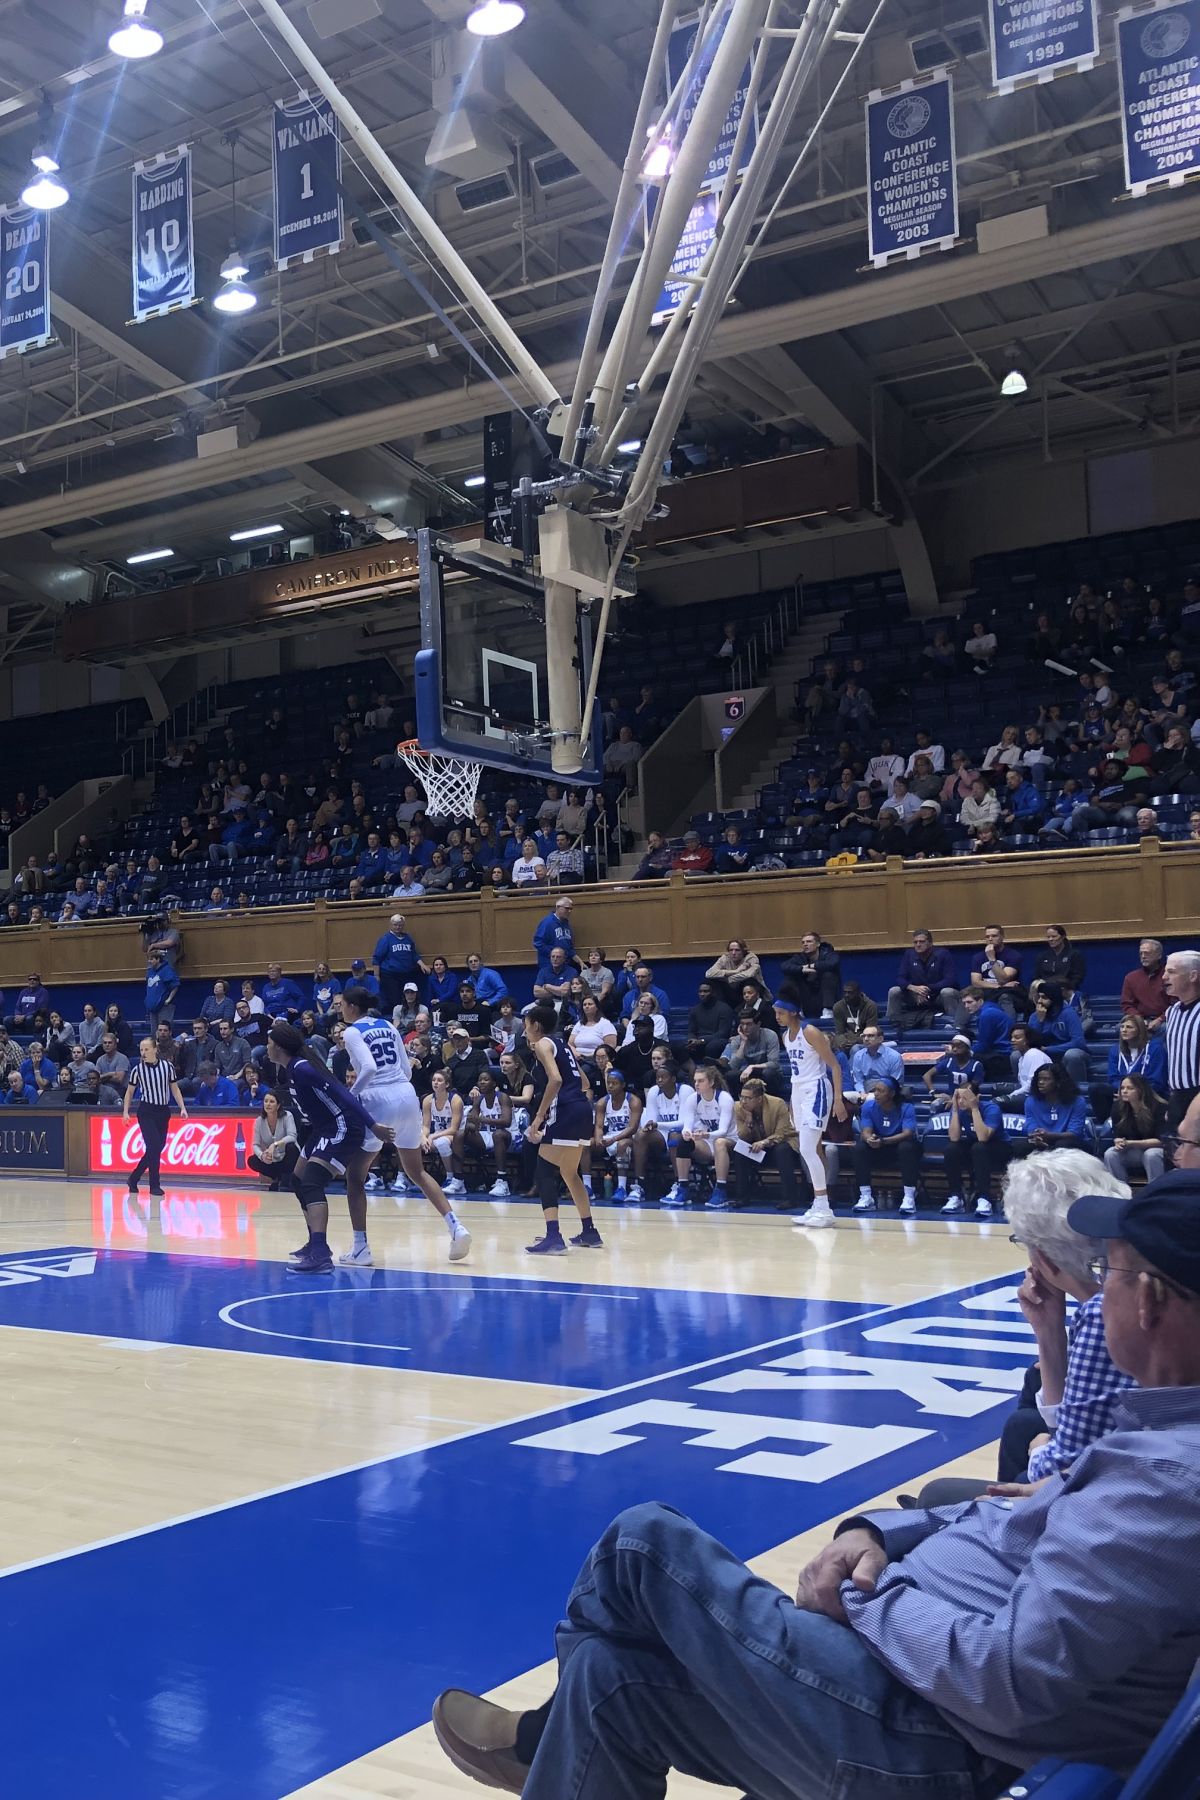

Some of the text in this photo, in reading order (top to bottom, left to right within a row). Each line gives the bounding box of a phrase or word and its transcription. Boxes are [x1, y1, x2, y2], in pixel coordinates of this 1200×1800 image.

[1003, 1, 1084, 35] CHAMPIONS
[1048, 21, 1078, 37] SEASON
[1026, 42, 1064, 64] 1999
[1138, 56, 1199, 84] ATLANTIC
[1149, 72, 1190, 95] COAST
[884, 137, 936, 162] ATLANTIC
[1158, 149, 1194, 170] 2004
[892, 152, 929, 173] COAST
[301, 162, 313, 200] 1
[874, 160, 949, 192] CONFERENCE
[884, 176, 939, 201] WOMEN'S
[140, 178, 183, 212] HARDING
[878, 188, 947, 217] CHAMPIONS
[883, 203, 942, 224] REGULAR SEASON
[890, 212, 935, 231] TOURNAMENT
[6, 222, 40, 251] BEARD
[146, 219, 179, 257] 10
[896, 224, 929, 242] 2003
[6, 261, 40, 300] 20
[275, 566, 360, 598] CAMERON
[730, 703, 739, 716] 6
[364, 1027, 396, 1046] WILLIAMS
[370, 1042, 398, 1067] 25
[564, 1048, 576, 1067] 3
